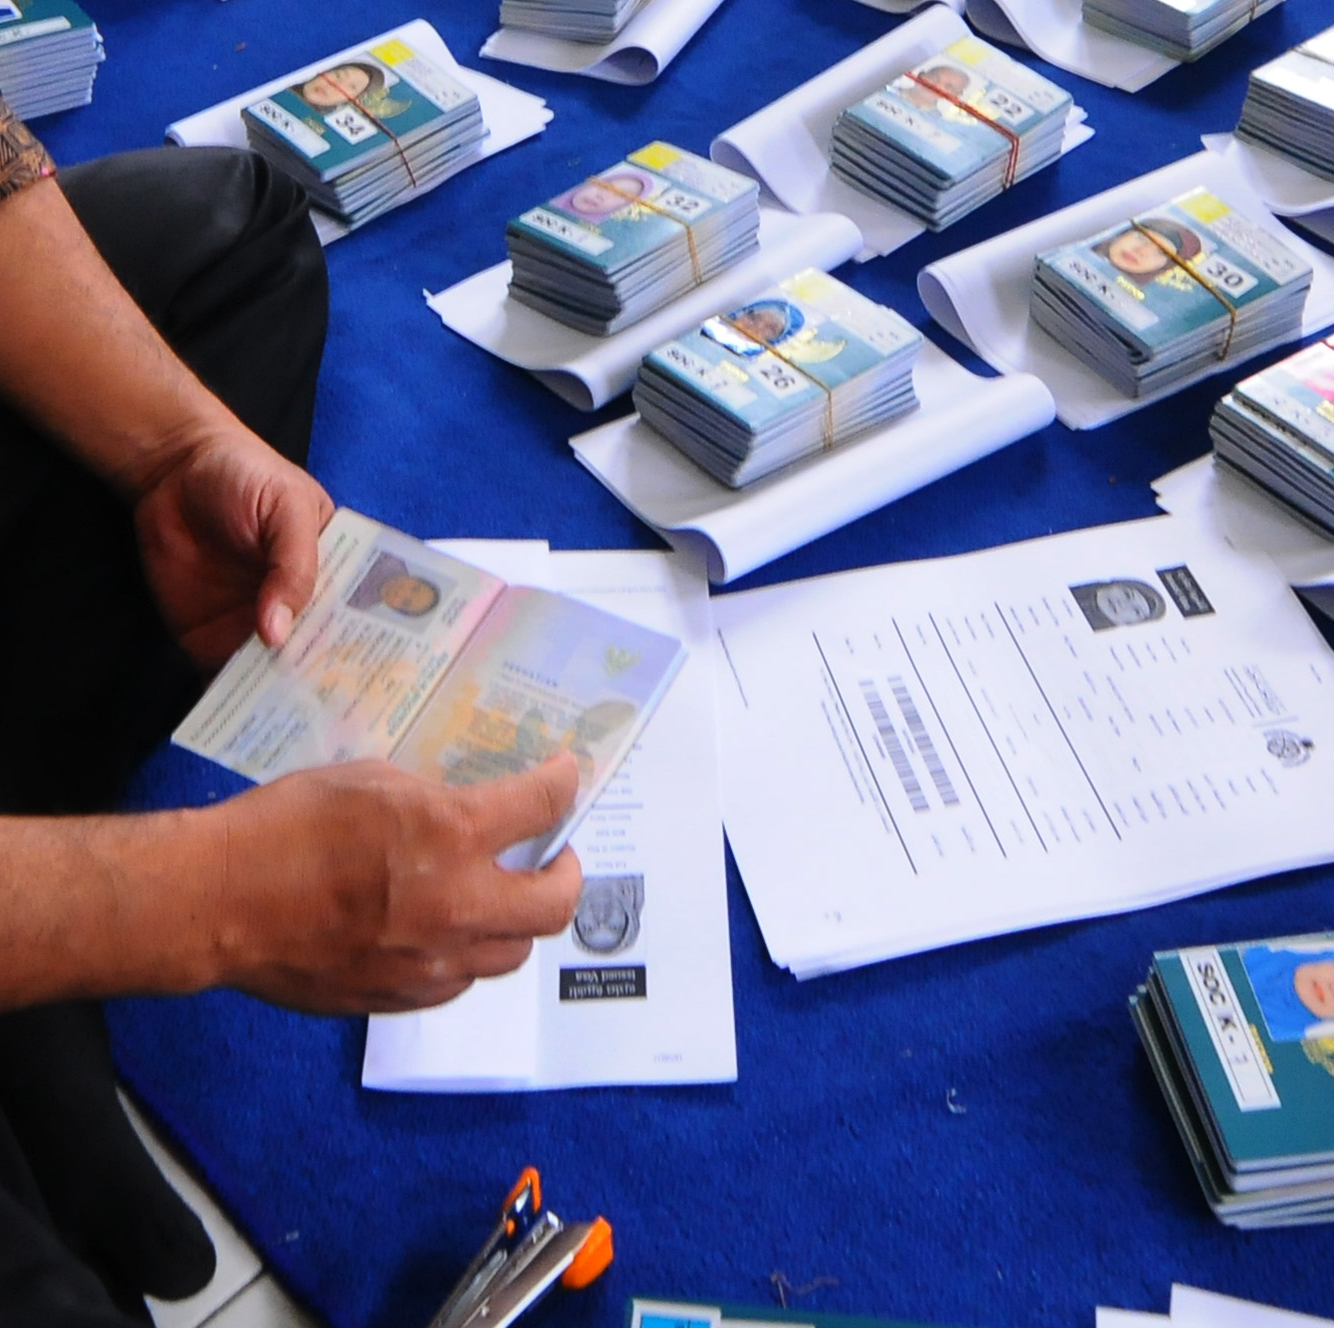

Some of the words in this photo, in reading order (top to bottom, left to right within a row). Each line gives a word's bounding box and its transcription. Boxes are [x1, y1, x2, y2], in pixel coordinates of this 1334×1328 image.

[990, 92, 1024, 119] 22
[665, 192, 701, 213] 32
[1206, 262, 1246, 289] 30
[759, 363, 797, 391] 26
[1196, 961, 1227, 1006] SOC
